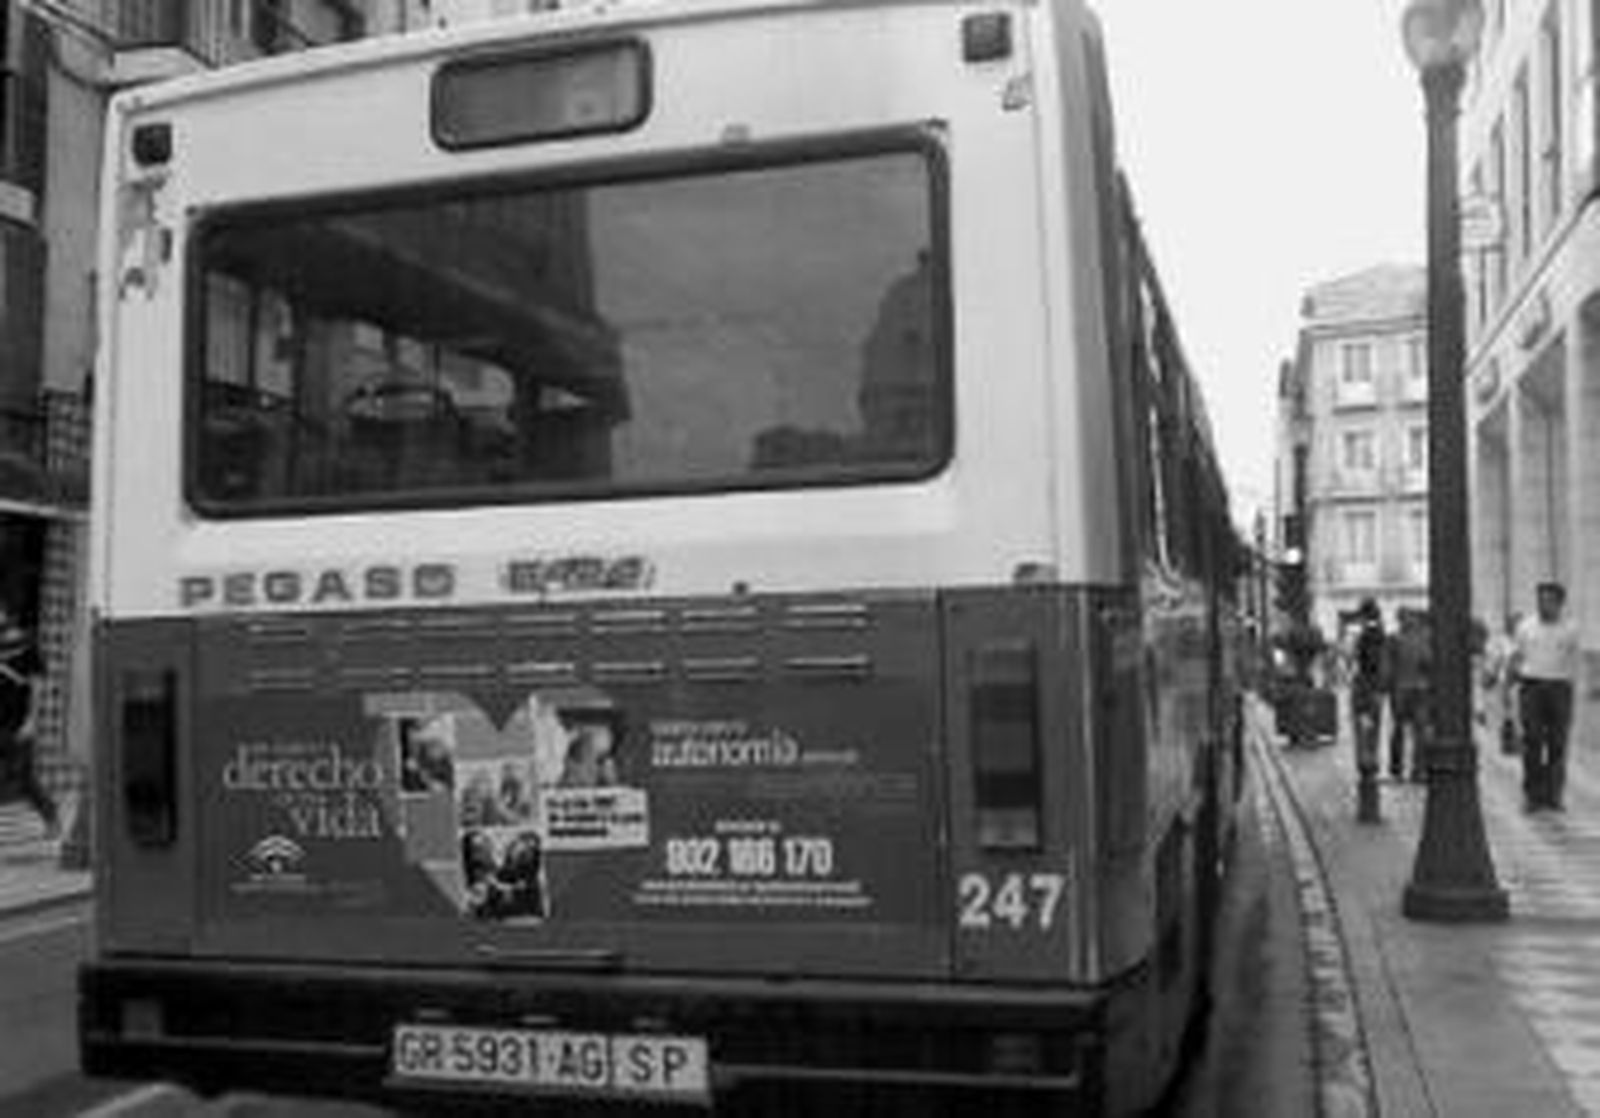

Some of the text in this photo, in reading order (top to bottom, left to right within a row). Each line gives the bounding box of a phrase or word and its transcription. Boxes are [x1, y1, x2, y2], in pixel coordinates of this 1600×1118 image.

[178, 563, 456, 606] PEGASO
[222, 743, 385, 791] derecho
[291, 793, 382, 838] vida
[959, 871, 1065, 931] 247
